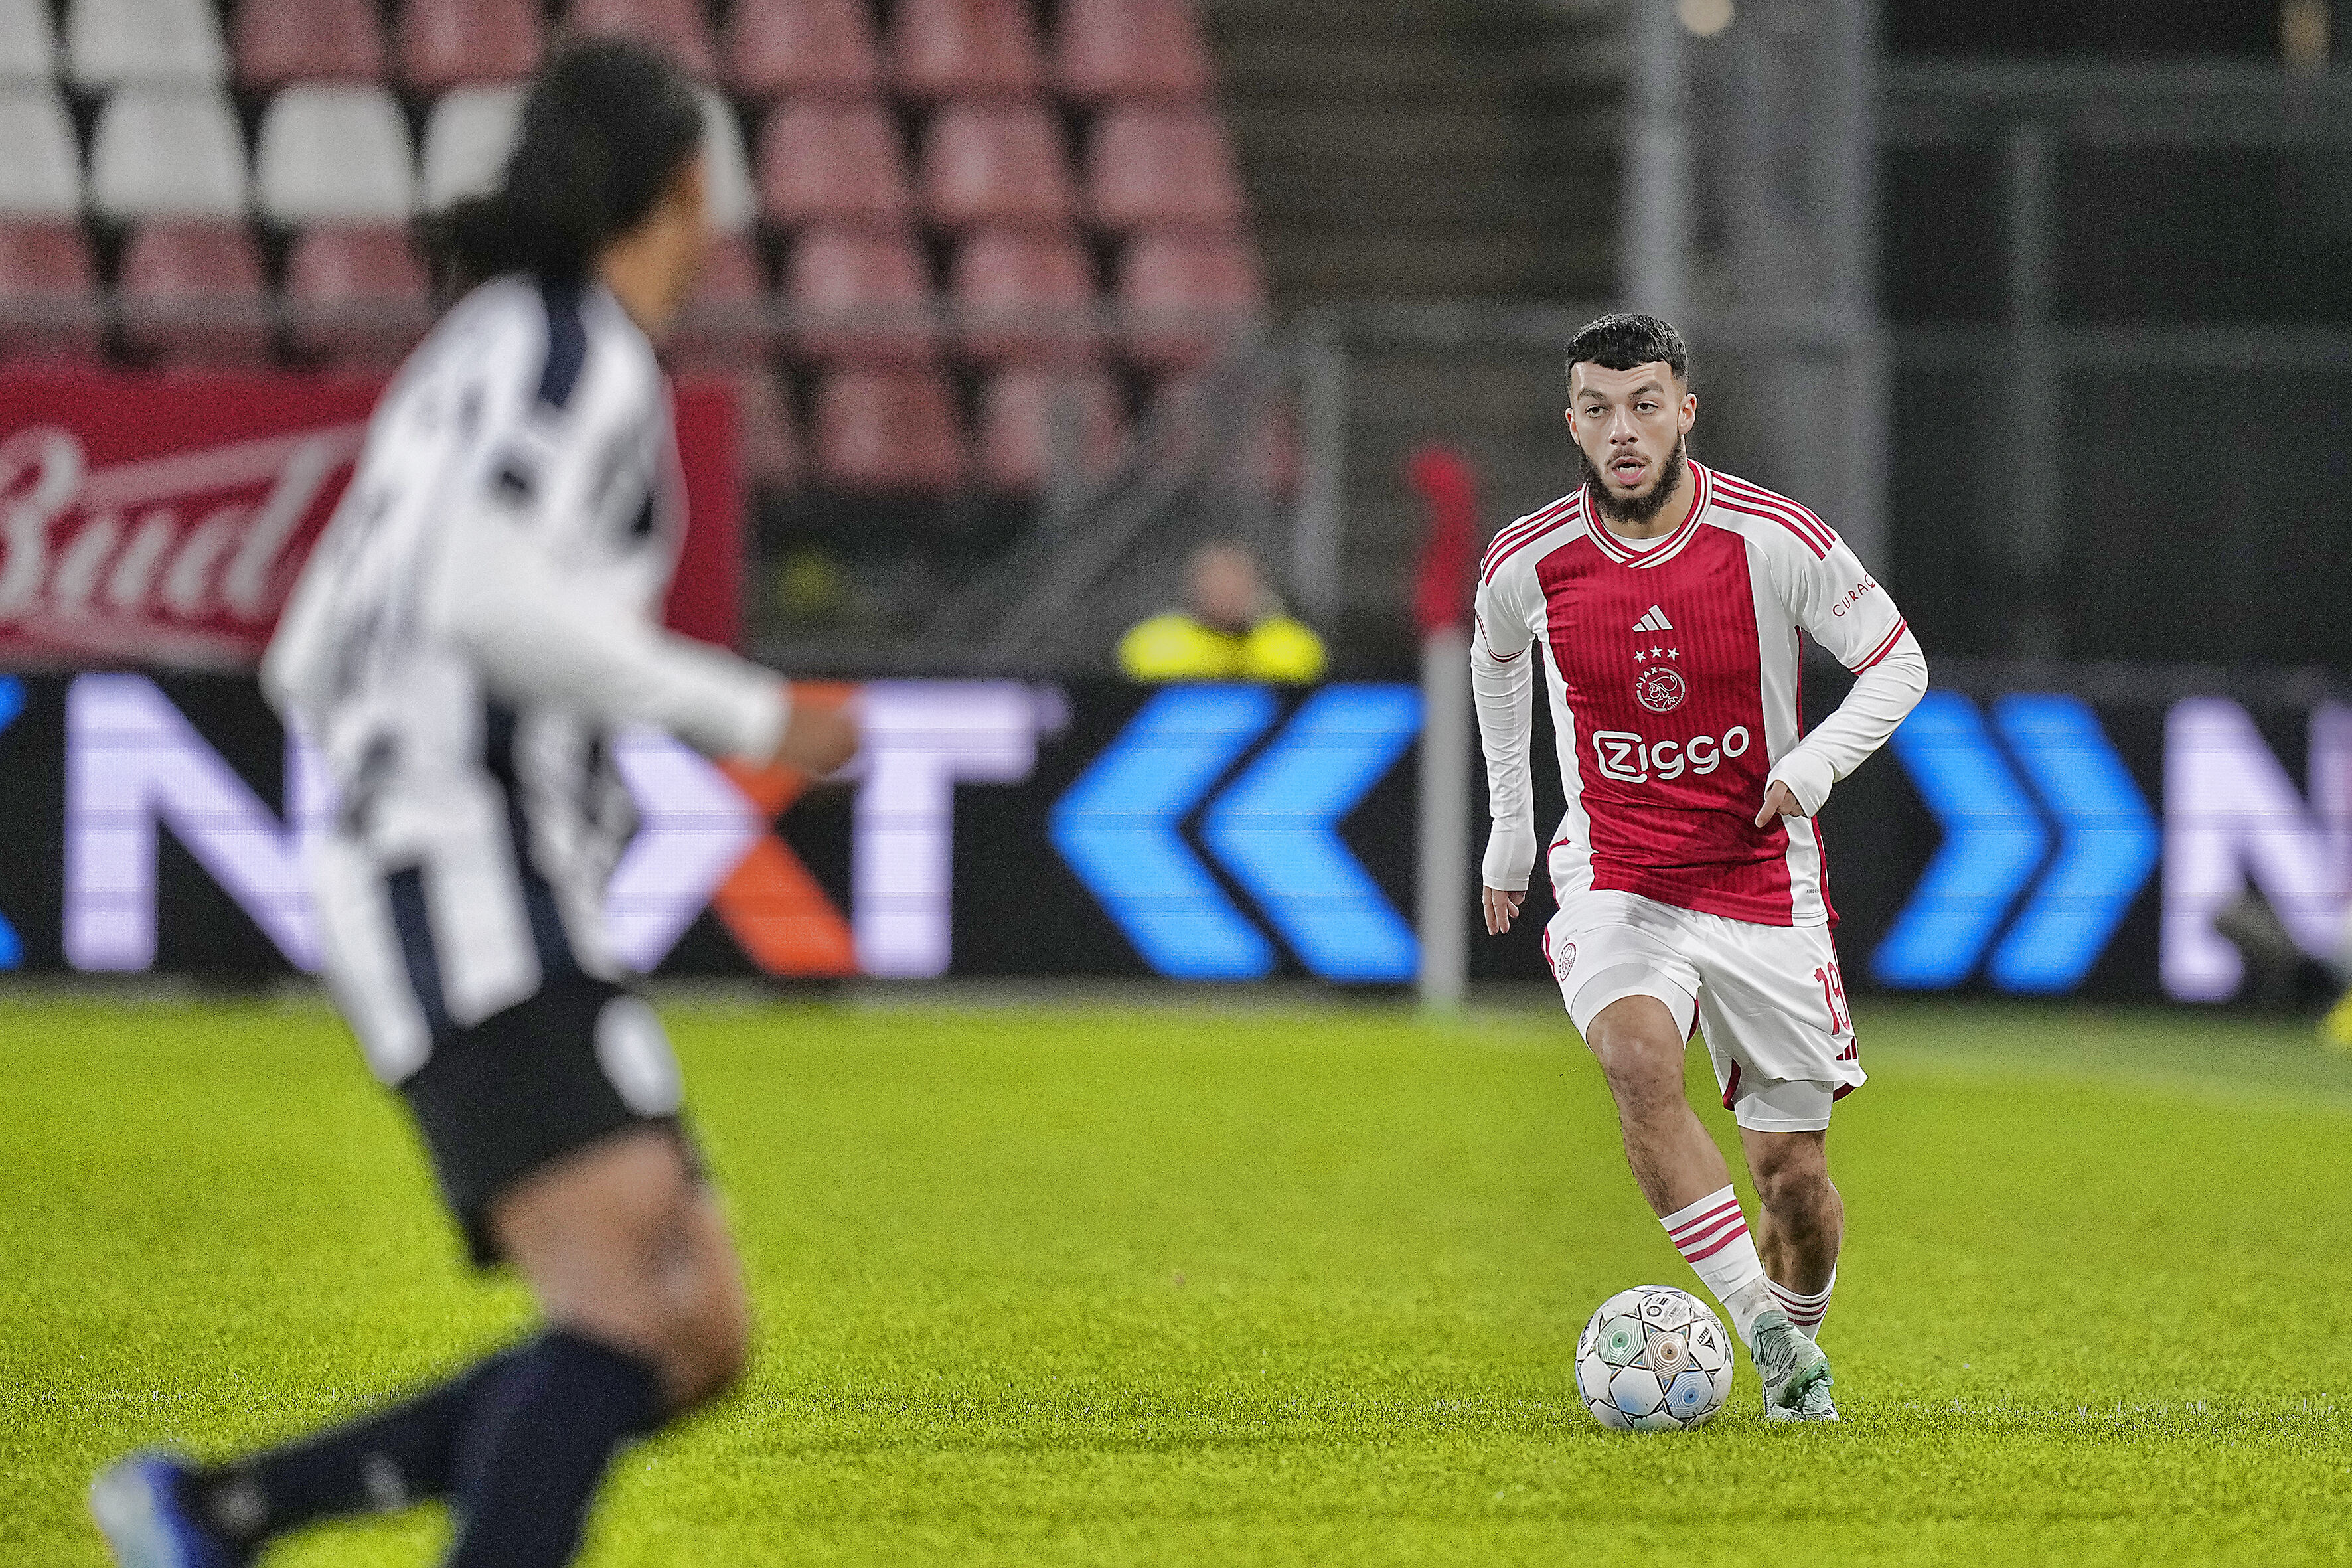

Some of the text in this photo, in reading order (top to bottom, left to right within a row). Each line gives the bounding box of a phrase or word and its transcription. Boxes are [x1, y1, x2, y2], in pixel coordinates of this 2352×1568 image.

[1636, 667, 1658, 689] AJAX
[1592, 726, 1750, 783] Ziggo
[62, 672, 1037, 979] NXT
[1814, 961, 1850, 1035] 19
